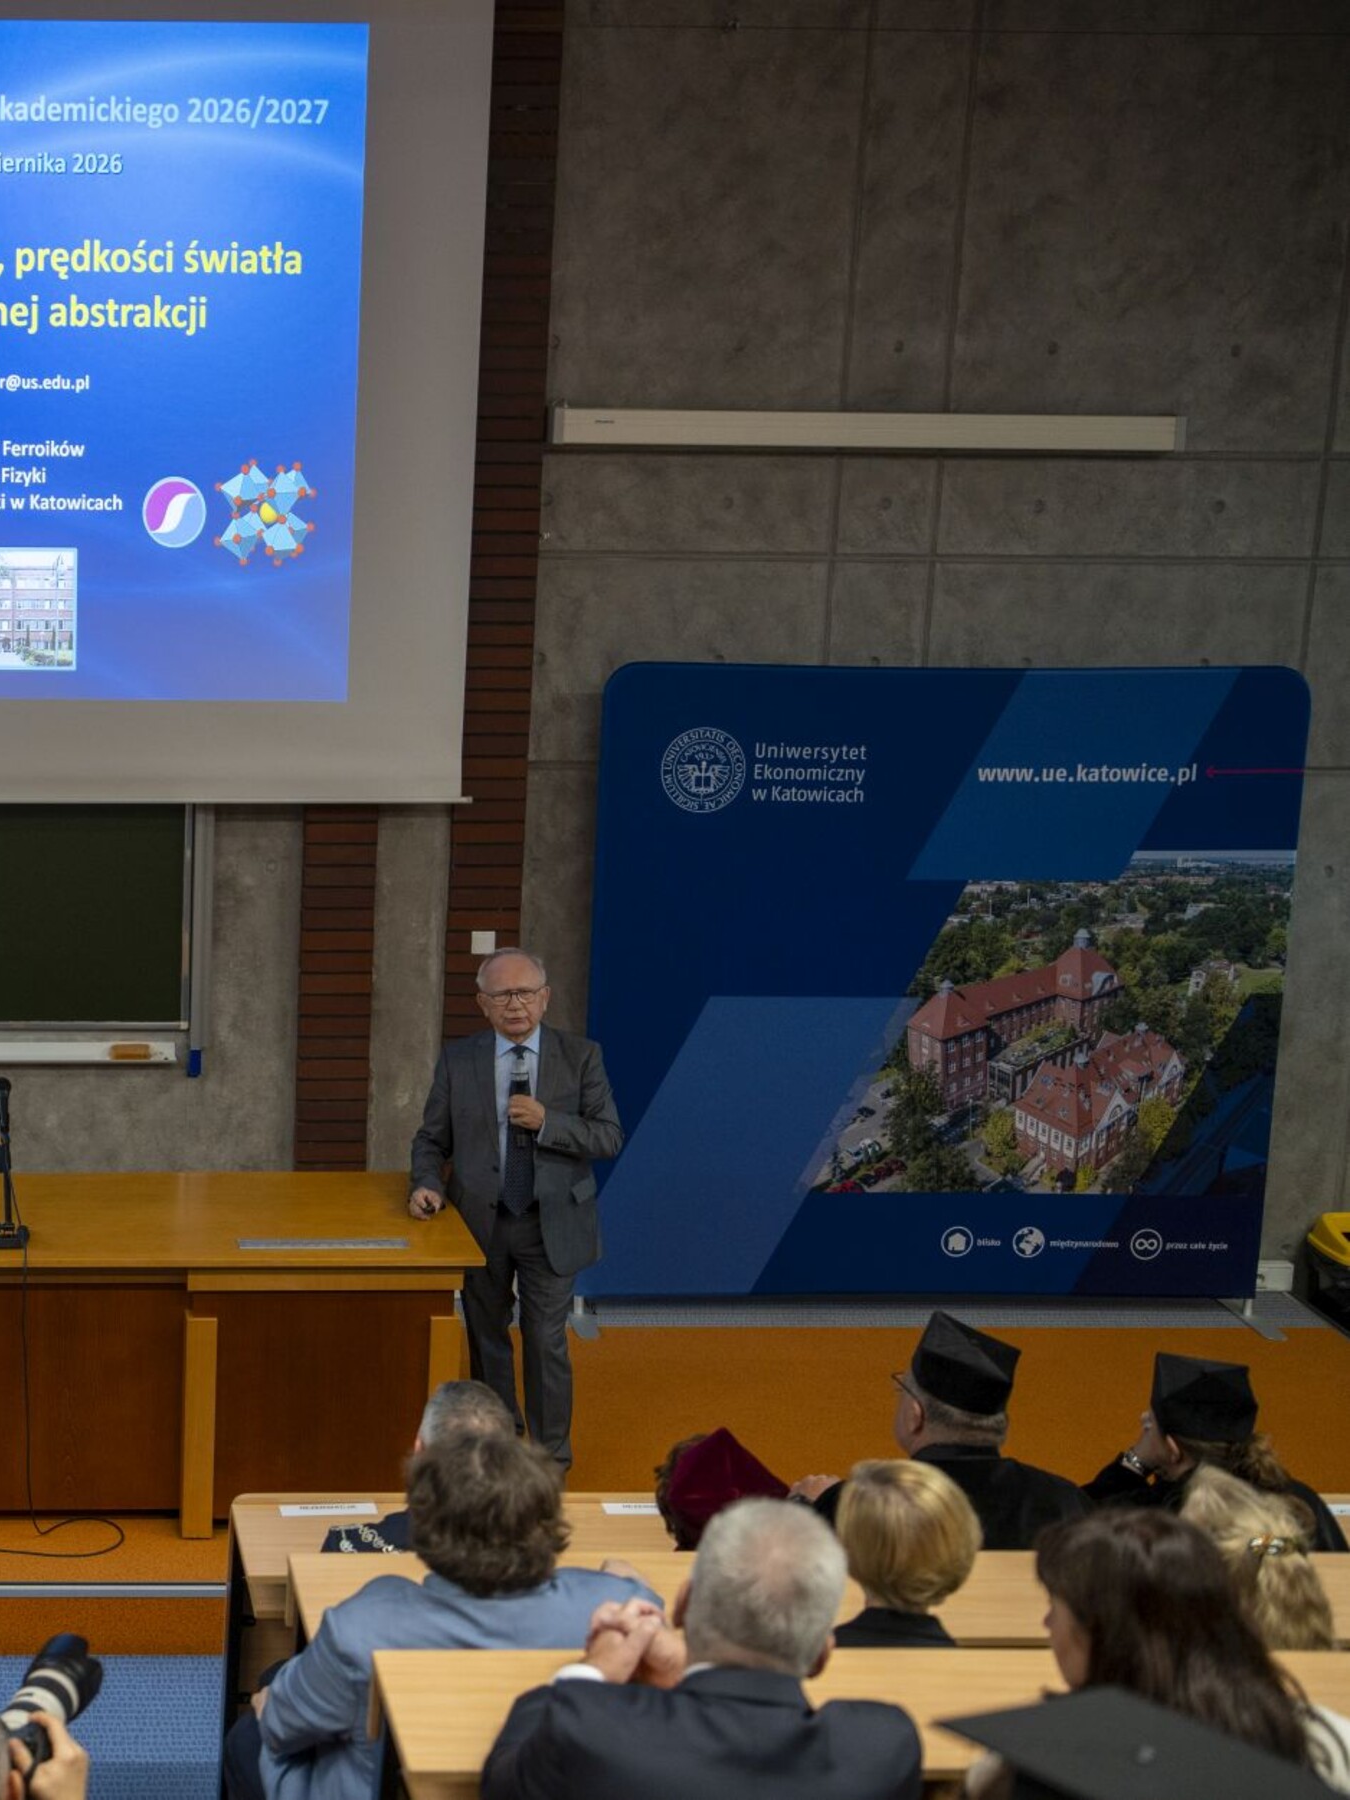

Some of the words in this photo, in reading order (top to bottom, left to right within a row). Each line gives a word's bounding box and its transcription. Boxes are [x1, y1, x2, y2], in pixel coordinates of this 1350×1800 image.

[188, 97, 329, 127] 2026/2027
[73, 153, 121, 173] 2026
[16, 239, 173, 279] prędkości
[184, 240, 301, 274] światła
[50, 294, 207, 336] abstrakcji
[3, 440, 85, 457] Ferroików
[2, 467, 46, 487] Fizyki
[10, 498, 25, 509] w
[30, 494, 122, 510] Katowicach
[755, 742, 866, 763] Uniwersytet
[754, 764, 865, 785] Ekonomiczny
[978, 763, 1197, 785] www.ue.katowice.pl
[752, 789, 767, 801] w
[772, 786, 864, 802] Katowicach
